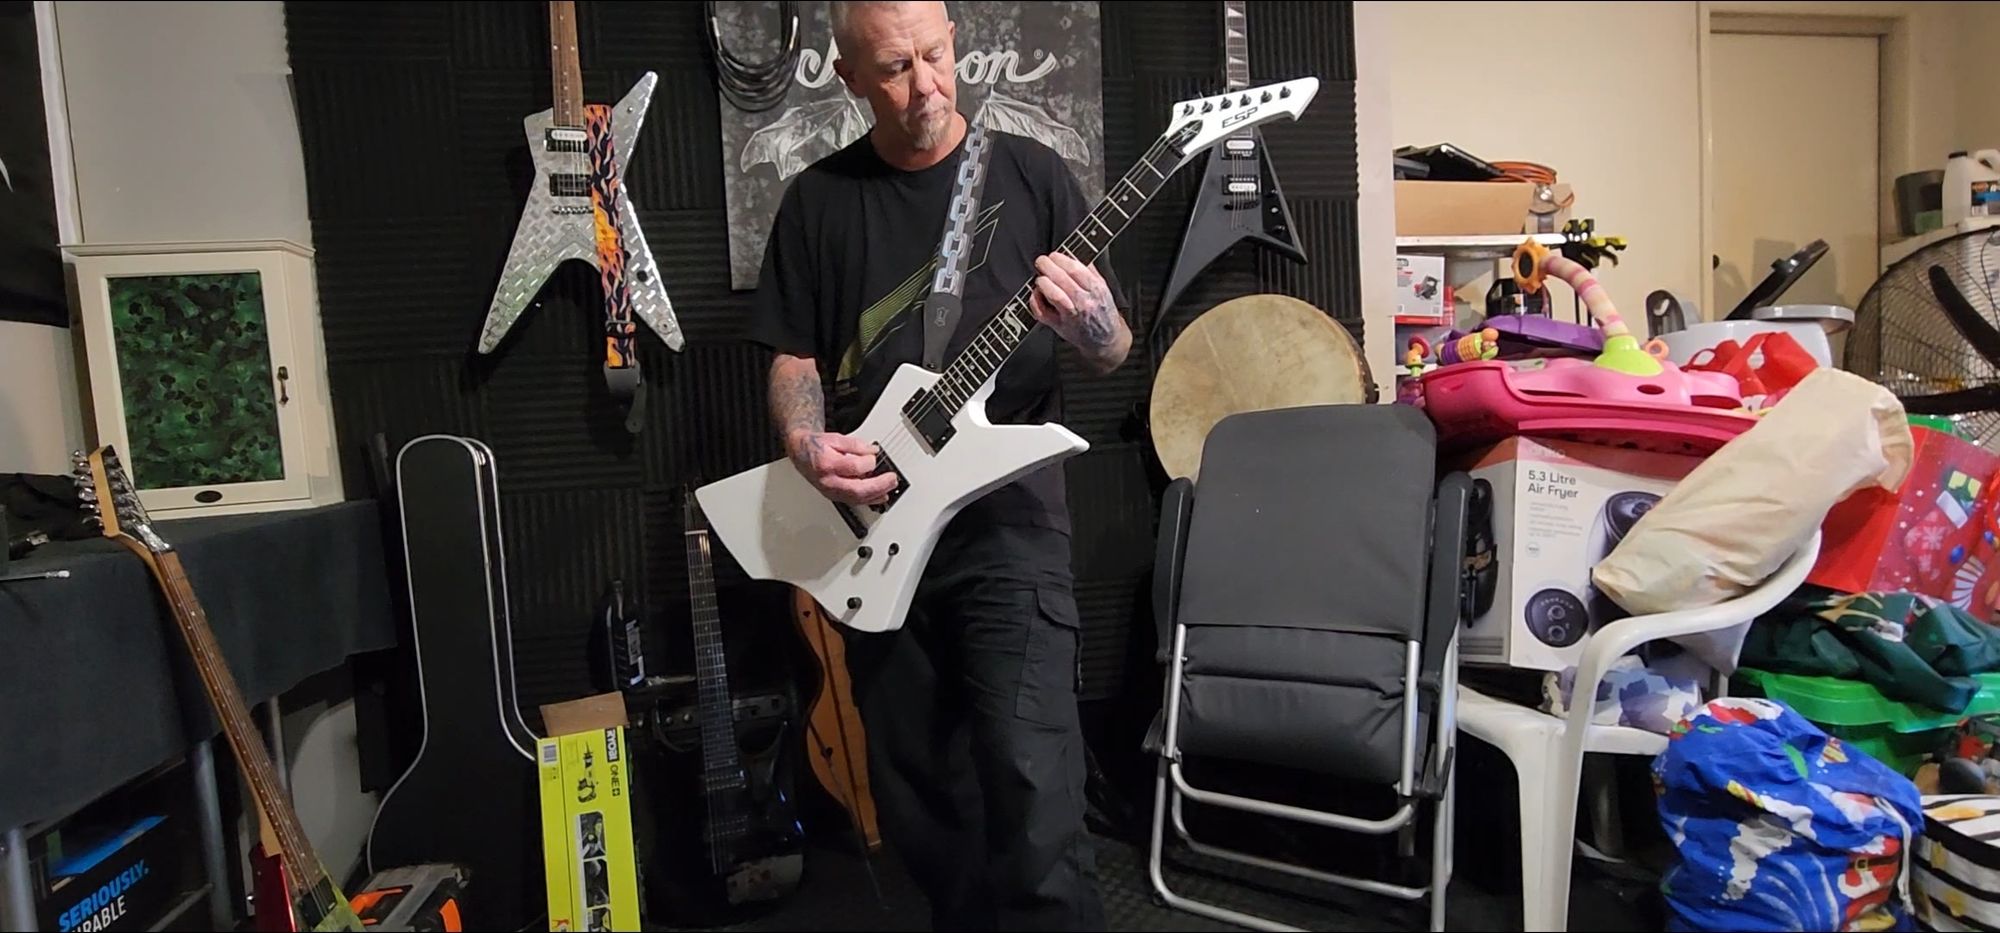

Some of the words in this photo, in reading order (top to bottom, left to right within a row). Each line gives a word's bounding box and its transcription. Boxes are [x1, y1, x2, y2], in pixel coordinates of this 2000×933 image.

[1222, 106, 1258, 129] ESP
[1528, 470, 1546, 481] 5.3
[1550, 472, 1576, 485] Litre
[1528, 483, 1545, 493] Air
[1548, 485, 1578, 499] Fryer
[606, 729, 618, 760] RYOBI
